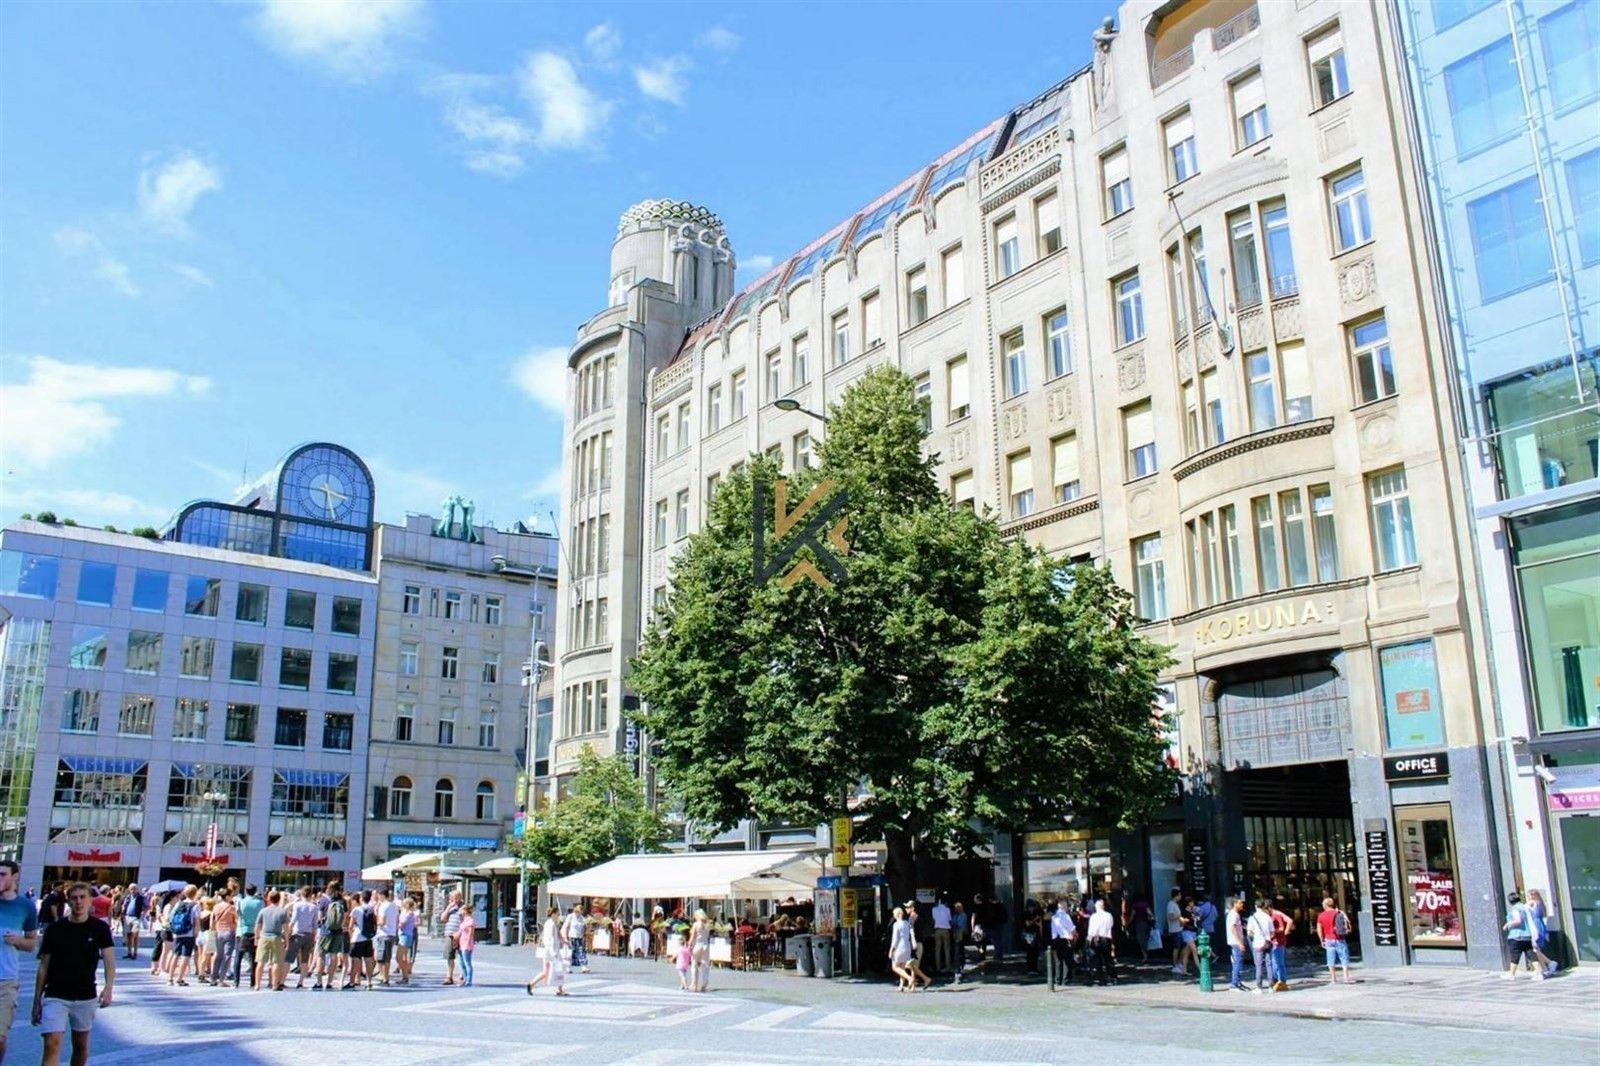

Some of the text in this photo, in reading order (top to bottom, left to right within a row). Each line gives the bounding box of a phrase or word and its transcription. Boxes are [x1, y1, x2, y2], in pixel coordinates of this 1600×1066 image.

[1199, 600, 1323, 646] KORUNA
[1395, 757, 1437, 771] OFFICE
[1408, 875, 1431, 884] FINAL
